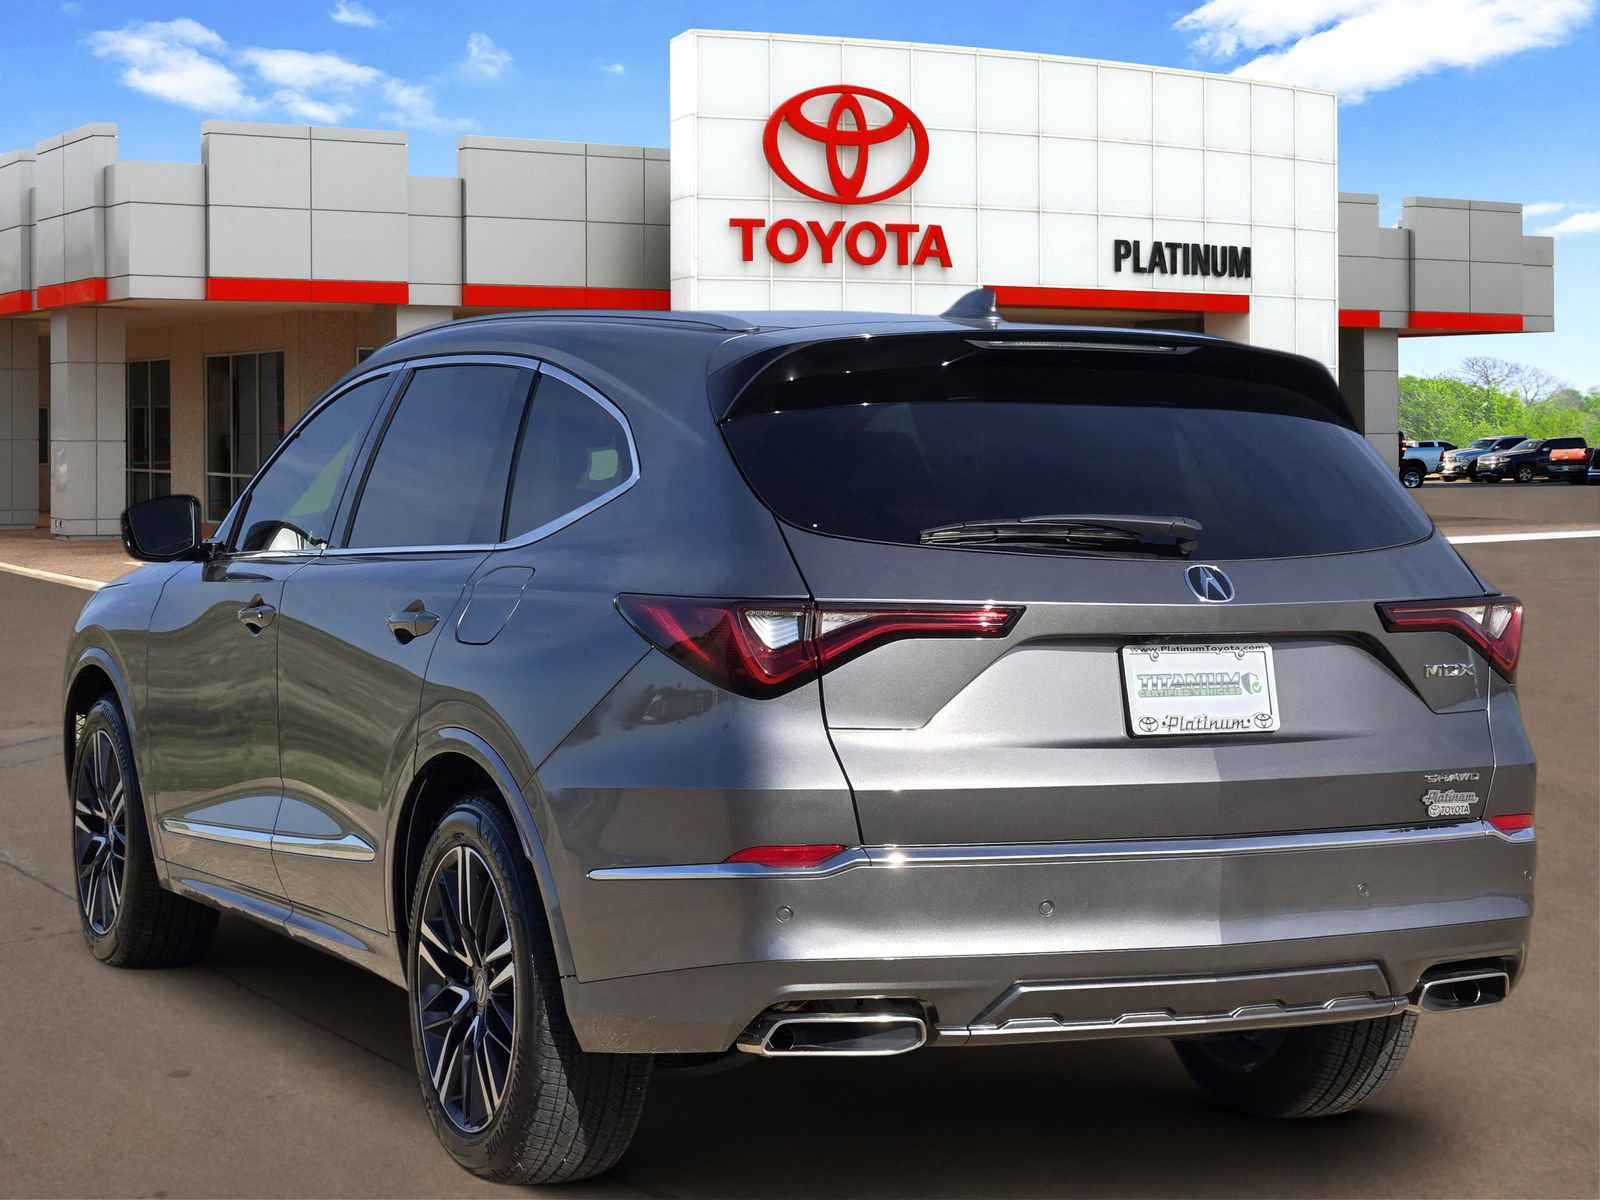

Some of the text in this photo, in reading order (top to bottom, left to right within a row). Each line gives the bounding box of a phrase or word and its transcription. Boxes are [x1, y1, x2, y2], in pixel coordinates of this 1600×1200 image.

[729, 218, 953, 269] TOYOTA
[1114, 239, 1252, 279] PLATINUM
[1424, 663, 1475, 677] MDX
[1137, 672, 1241, 689] TITANIUM
[1166, 714, 1250, 731] Platinum
[1441, 804, 1470, 815] TOYOTA
